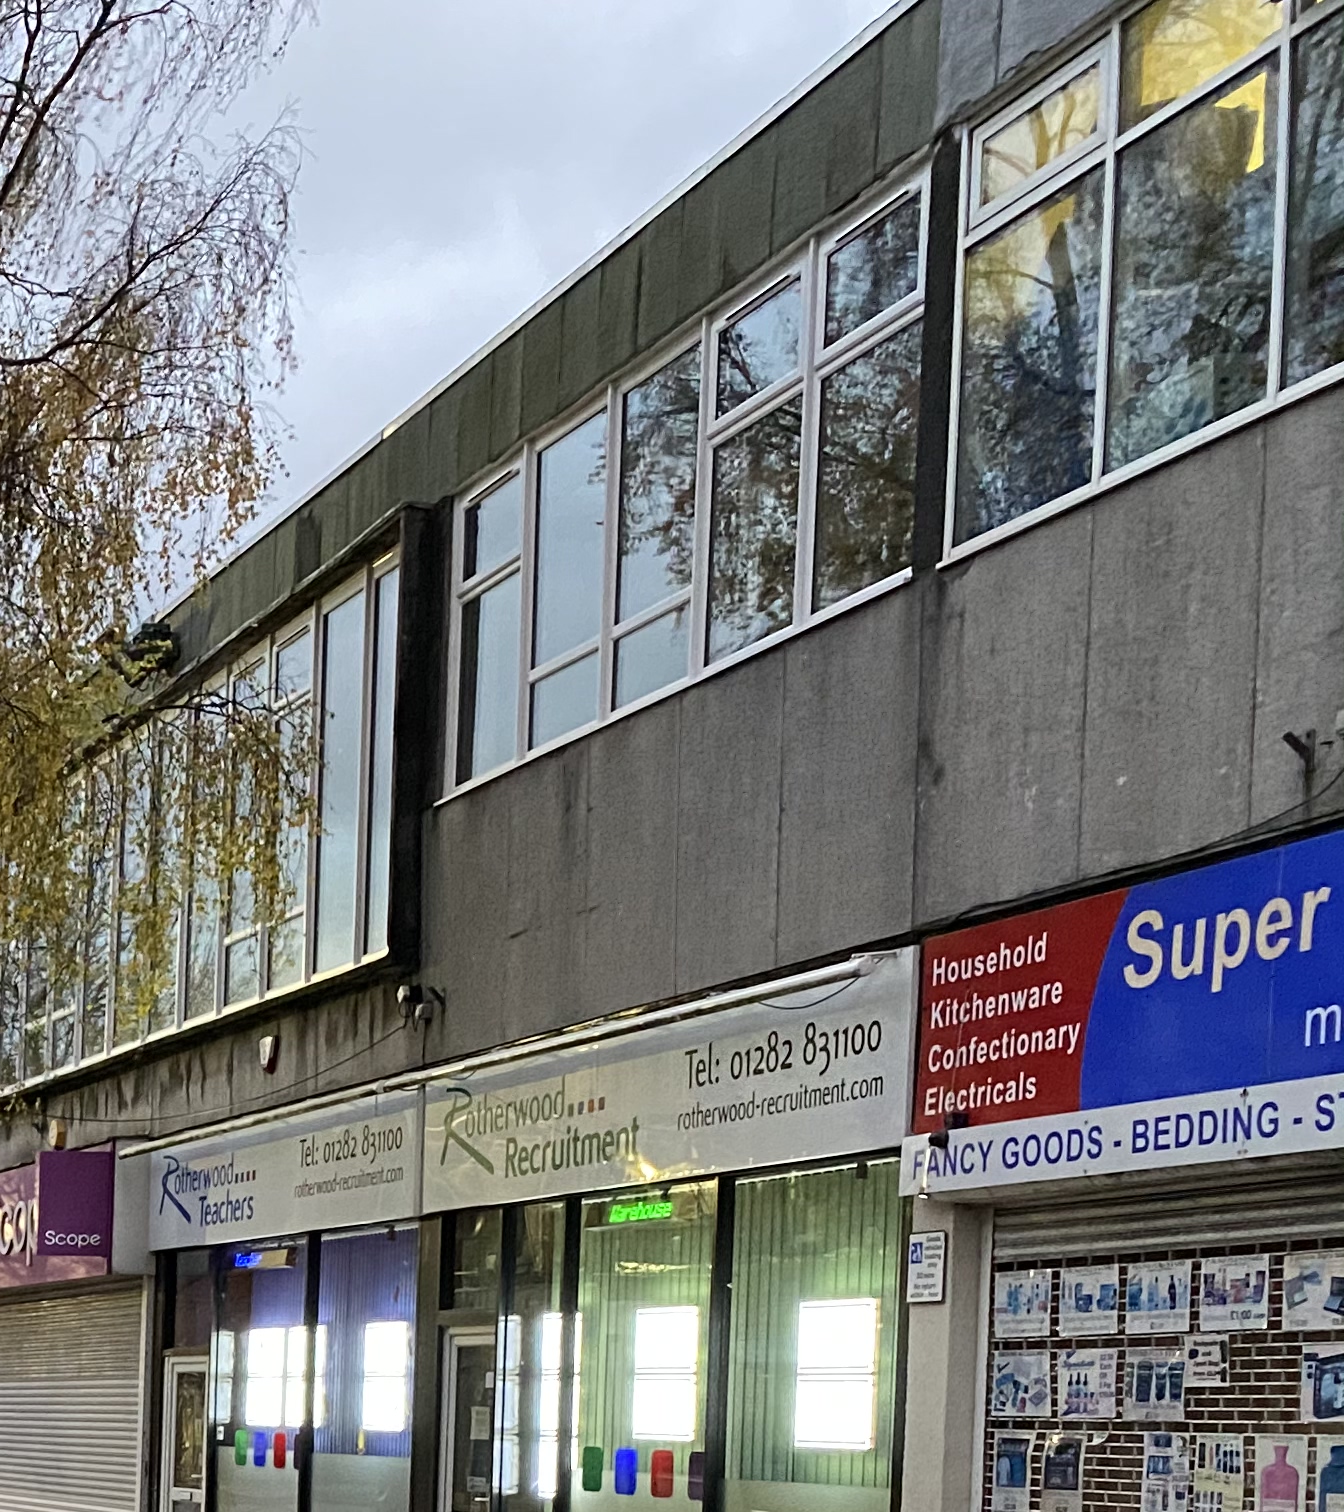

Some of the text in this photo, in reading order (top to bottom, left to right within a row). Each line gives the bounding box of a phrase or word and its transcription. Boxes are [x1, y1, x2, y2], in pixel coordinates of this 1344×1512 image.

[932, 931, 1048, 987] Household
[1123, 886, 1332, 993] Super
[930, 980, 1063, 1029] Kitchenware
[685, 1020, 882, 1089] Tel: 01282 831100
[928, 1022, 1081, 1073] Confectionary
[677, 1075, 884, 1131] rotherwood-recruitment.com
[924, 1071, 1037, 1116] Electricals
[299, 1125, 403, 1168] Tel: 01282 831100
[440, 1074, 566, 1175] Rotherwood
[505, 1115, 639, 1178] Recruitment
[913, 1140, 994, 1180] FANCY
[1002, 1125, 1103, 1169] GOODS
[1131, 1101, 1279, 1154] BEDDING
[160, 1152, 234, 1224] Rotherwood
[198, 1189, 254, 1227] Teachers
[294, 1166, 404, 1198] rotherwood-recruitment.com
[44, 1230, 101, 1248] Scope
